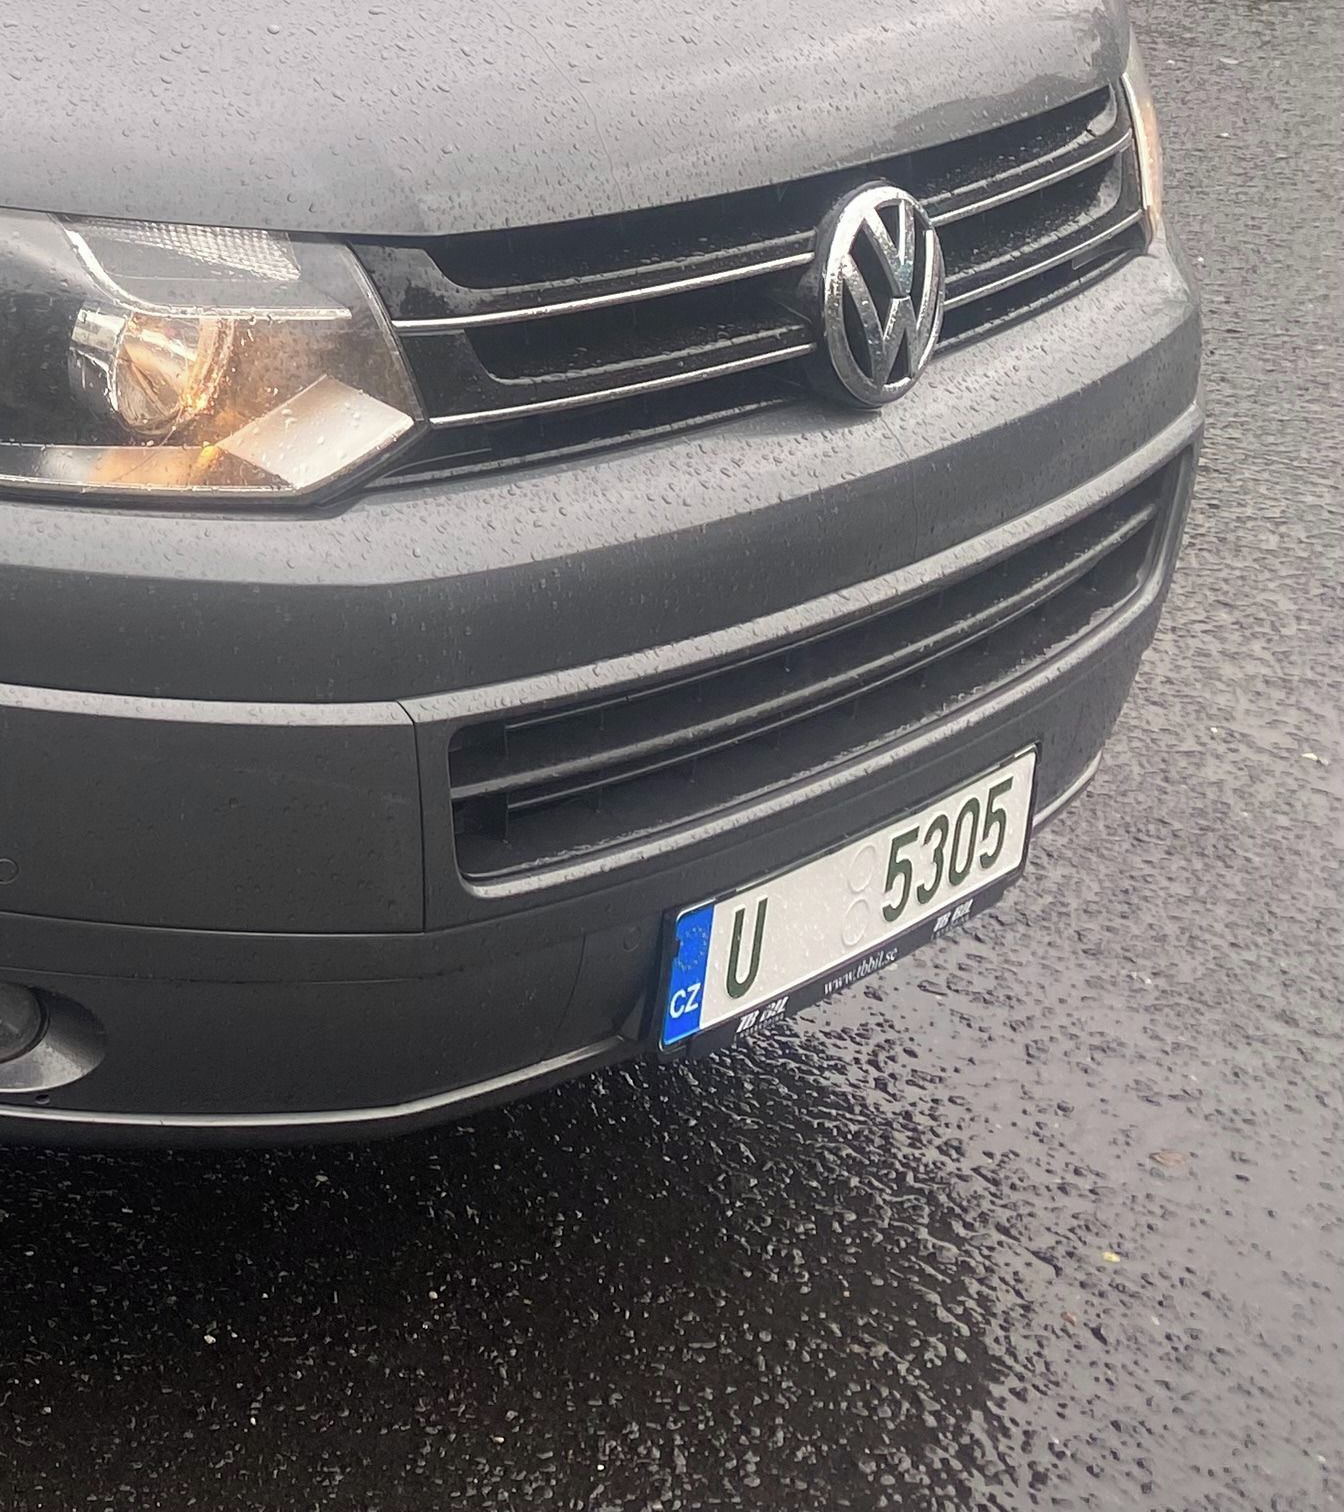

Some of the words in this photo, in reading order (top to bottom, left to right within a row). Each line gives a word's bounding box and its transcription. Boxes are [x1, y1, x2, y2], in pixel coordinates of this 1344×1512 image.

[725, 896, 769, 1000] U
[881, 775, 1015, 923] 5305
[669, 982, 701, 1019] CZ
